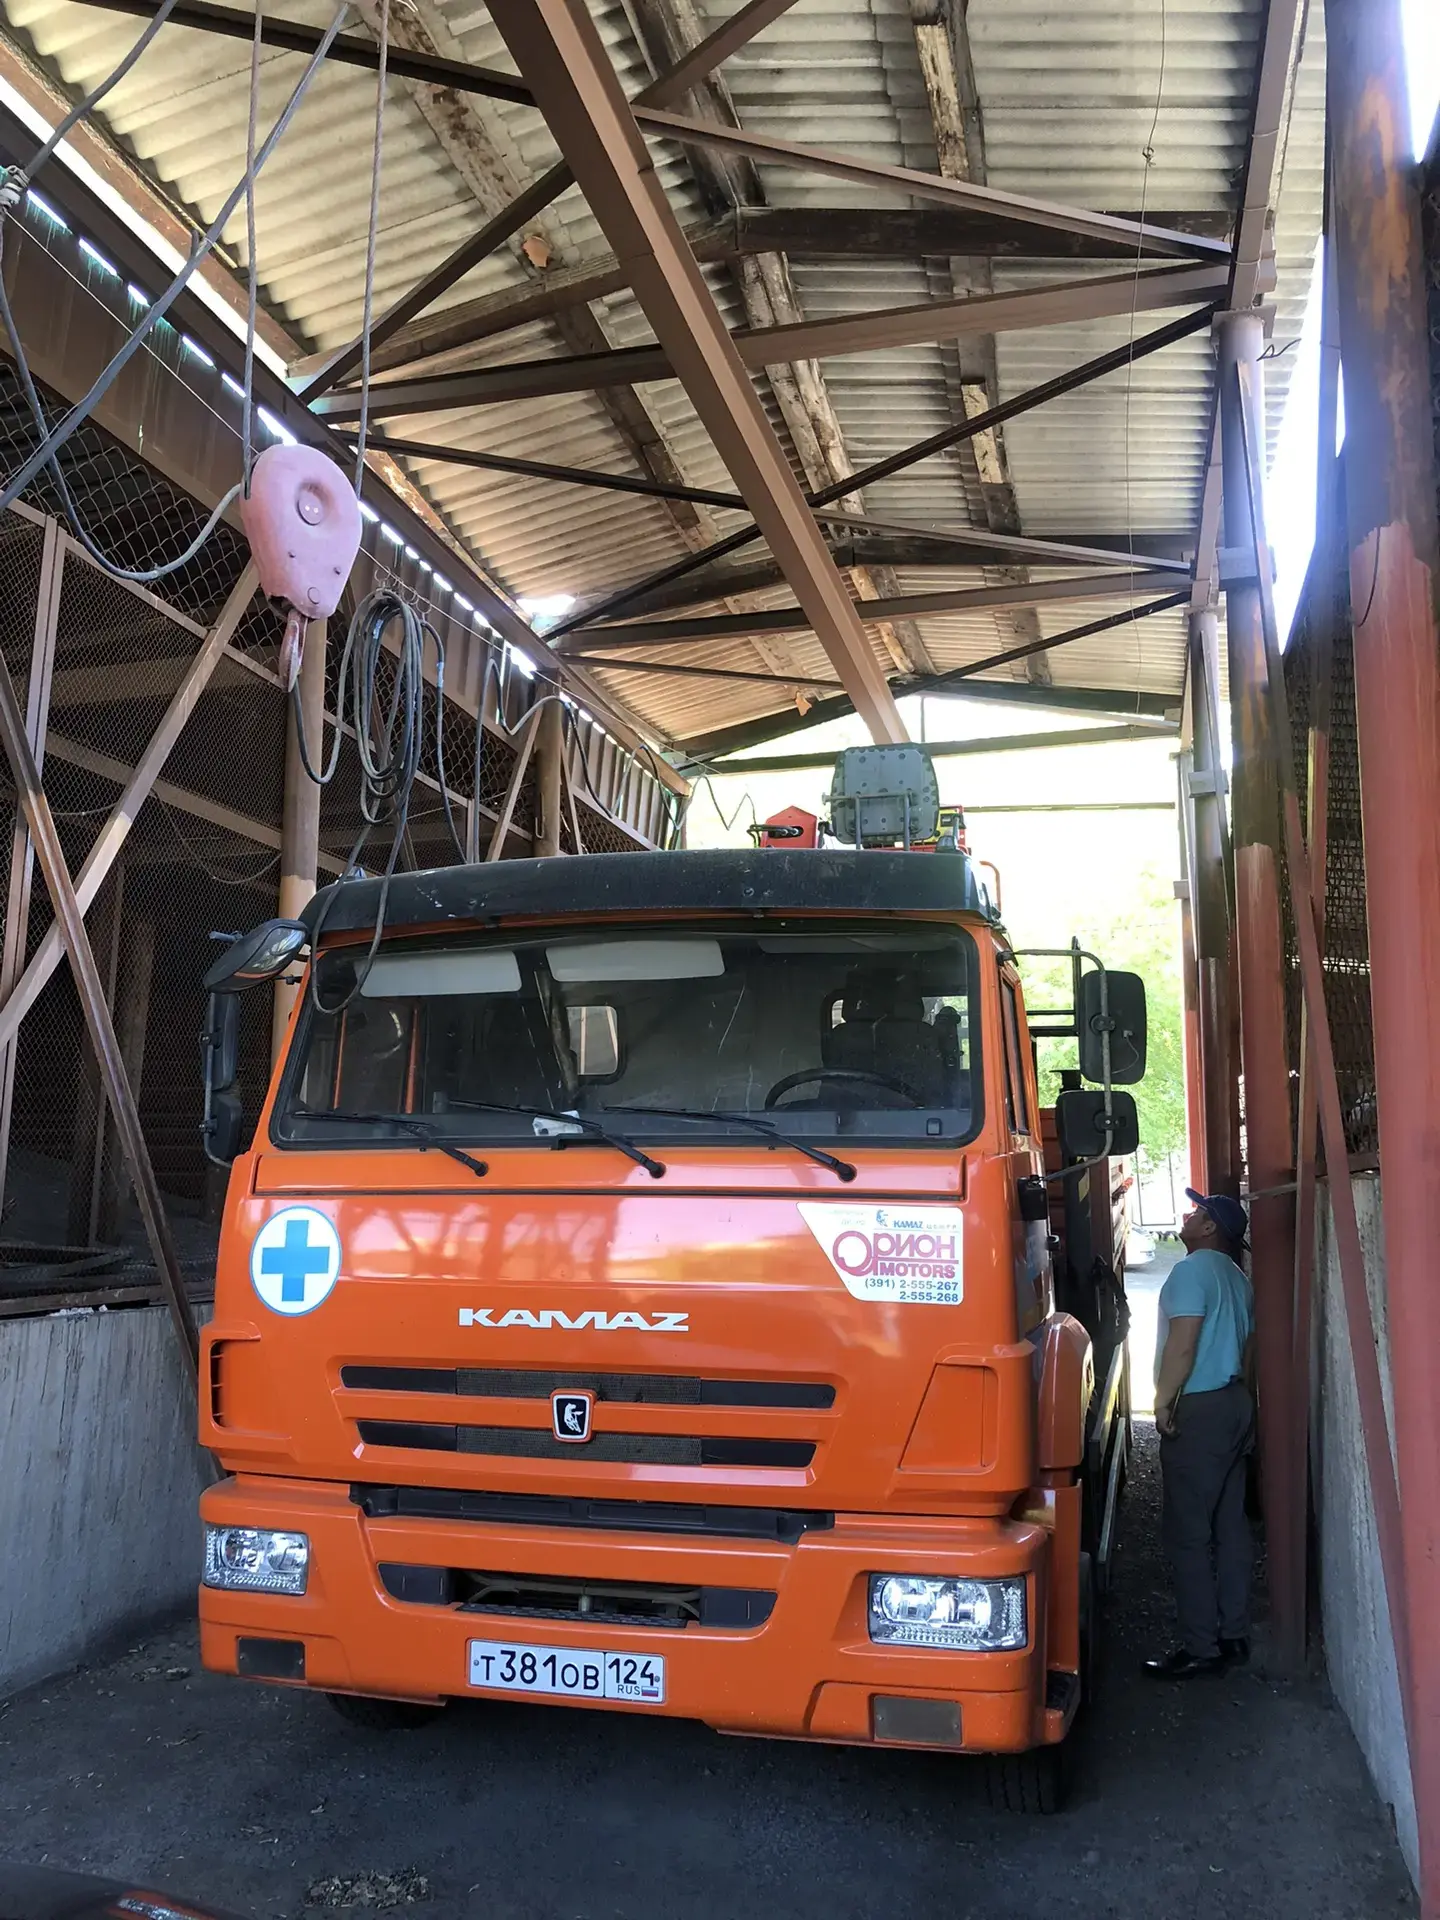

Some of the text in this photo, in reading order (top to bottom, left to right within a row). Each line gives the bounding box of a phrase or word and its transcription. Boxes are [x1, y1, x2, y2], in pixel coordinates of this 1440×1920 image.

[893, 1220, 923, 1229] KAMAZ
[879, 1262, 956, 1279] MOTORS
[864, 1278, 959, 1291] (391) 2-555-267
[899, 1291, 959, 1303] 2-555-268
[458, 1308, 689, 1331] KAMAZ
[608, 1657, 654, 1686] 124
[617, 1684, 641, 1696] RUS
